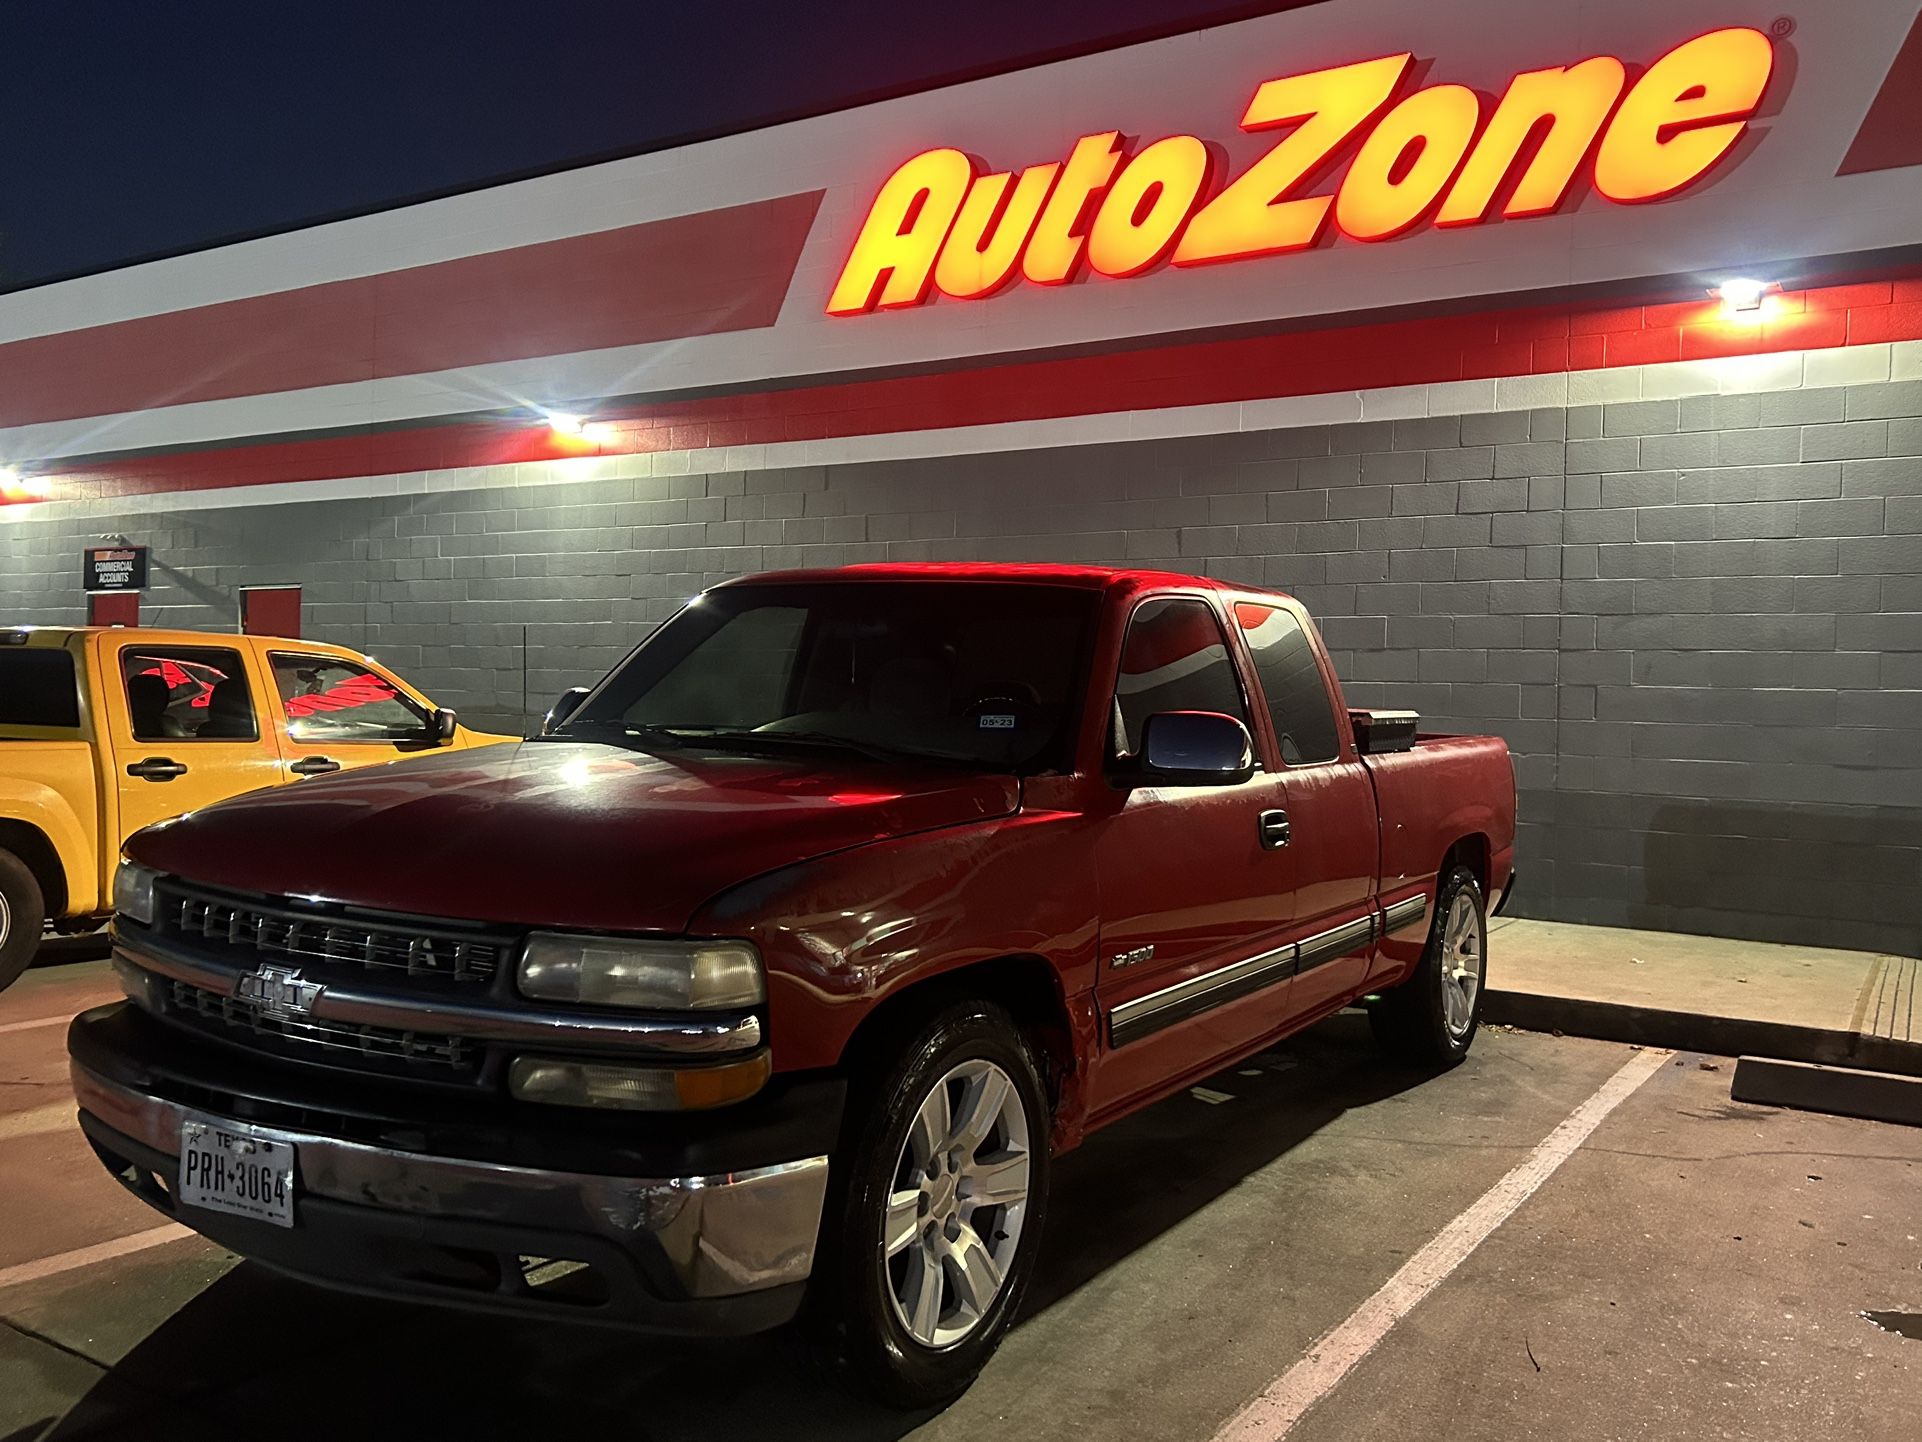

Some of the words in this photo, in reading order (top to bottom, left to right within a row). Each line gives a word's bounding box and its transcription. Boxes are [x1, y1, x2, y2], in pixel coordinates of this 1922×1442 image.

[824, 26, 1775, 317] AutoZone
[95, 560, 134, 573] COMMERCIAL
[98, 572, 130, 584] ACCOUNTS
[216, 1131, 257, 1155] TES
